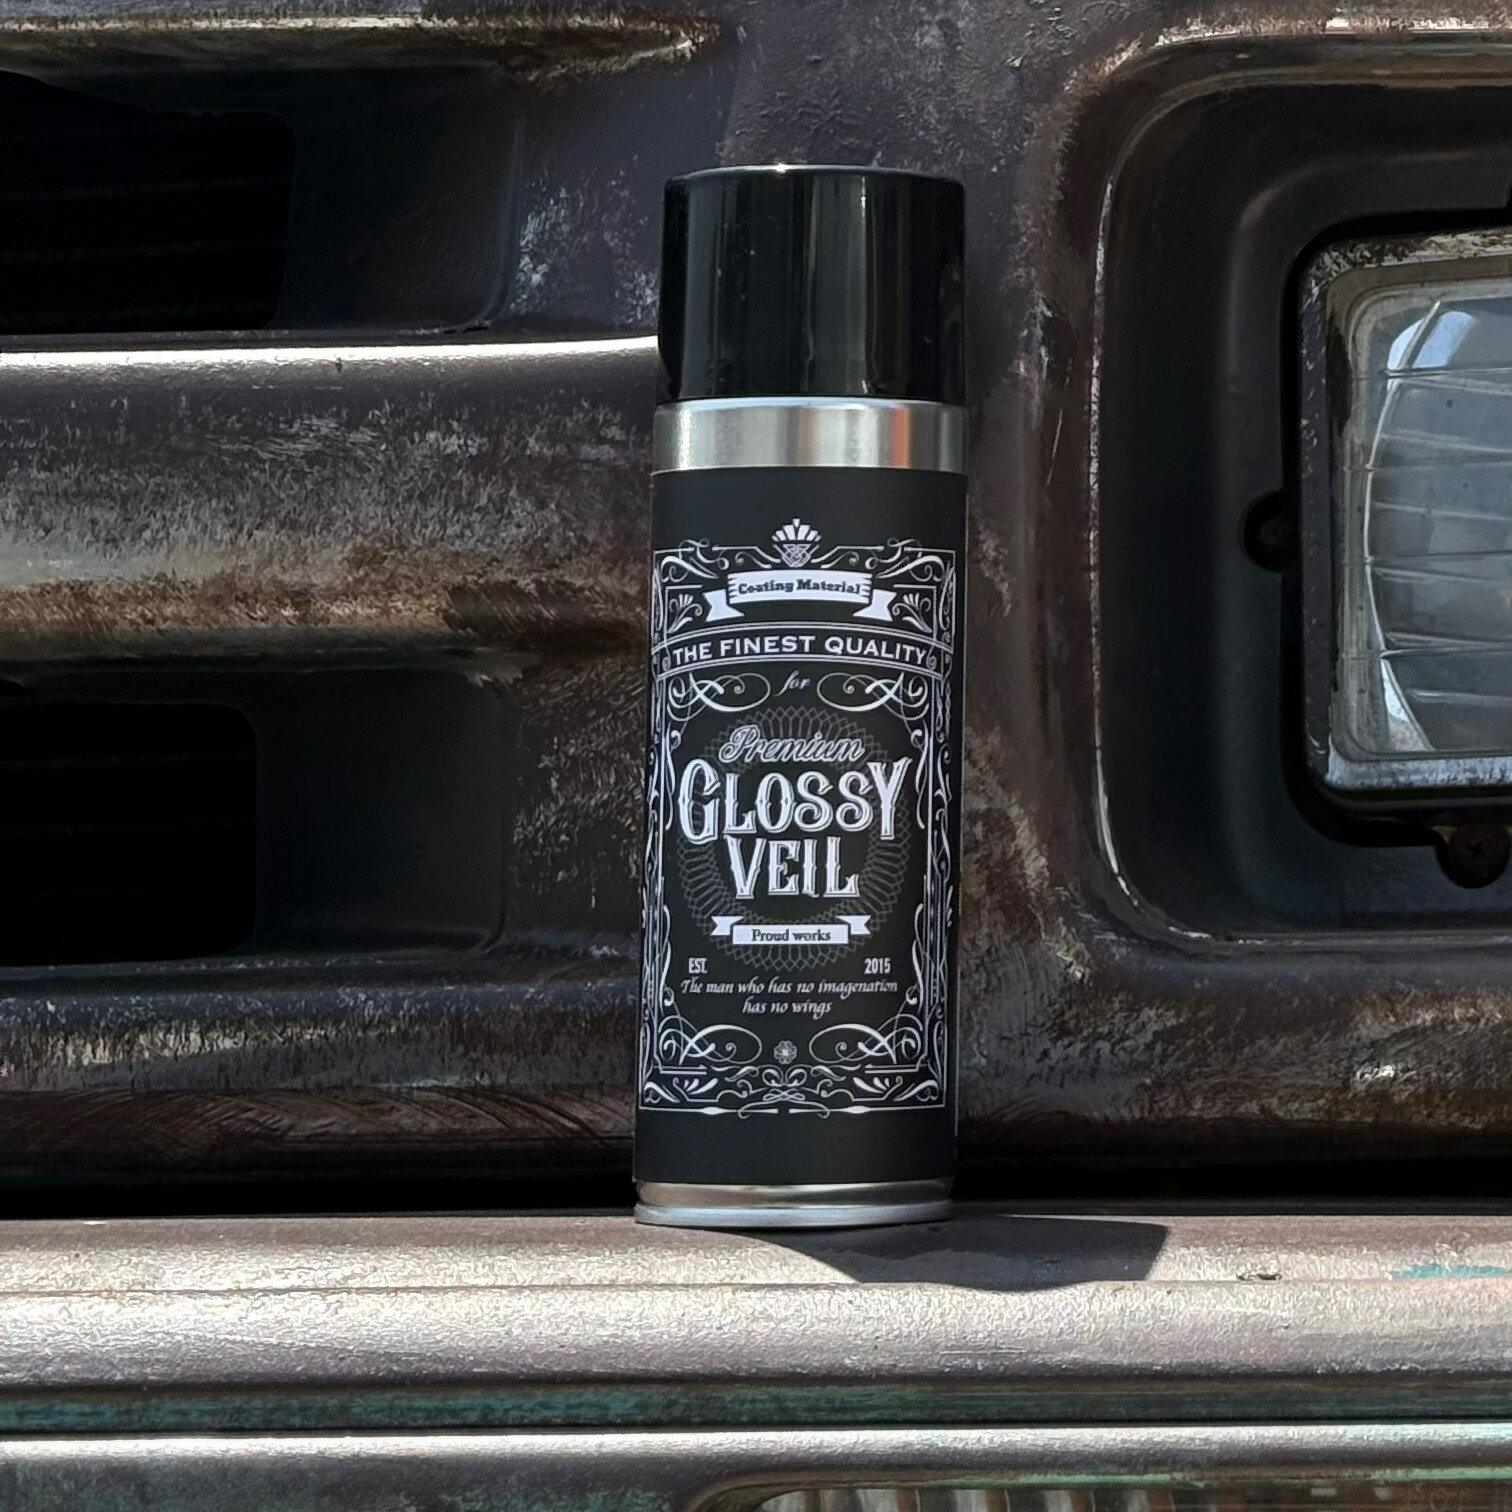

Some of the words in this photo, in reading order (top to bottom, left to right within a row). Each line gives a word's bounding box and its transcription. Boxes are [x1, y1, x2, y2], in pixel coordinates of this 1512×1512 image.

[738, 579, 795, 595] Coating
[796, 578, 861, 594] Material
[672, 641, 714, 666] THE
[720, 635, 816, 657] FINEST
[824, 636, 928, 666] QUALITY
[773, 669, 811, 697] for
[718, 724, 865, 764] Premium
[678, 756, 913, 845] GLOSSY
[723, 835, 861, 899] VEIL
[751, 928, 790, 942] Proud
[792, 928, 832, 942] works
[864, 957, 891, 974] 2015
[681, 976, 703, 994] The
[706, 982, 734, 994] man
[738, 975, 765, 993] who
[768, 975, 793, 993] has
[797, 982, 815, 993] no
[742, 995, 767, 1014] has
[771, 1002, 789, 1014] no
[791, 999, 833, 1020] wings
